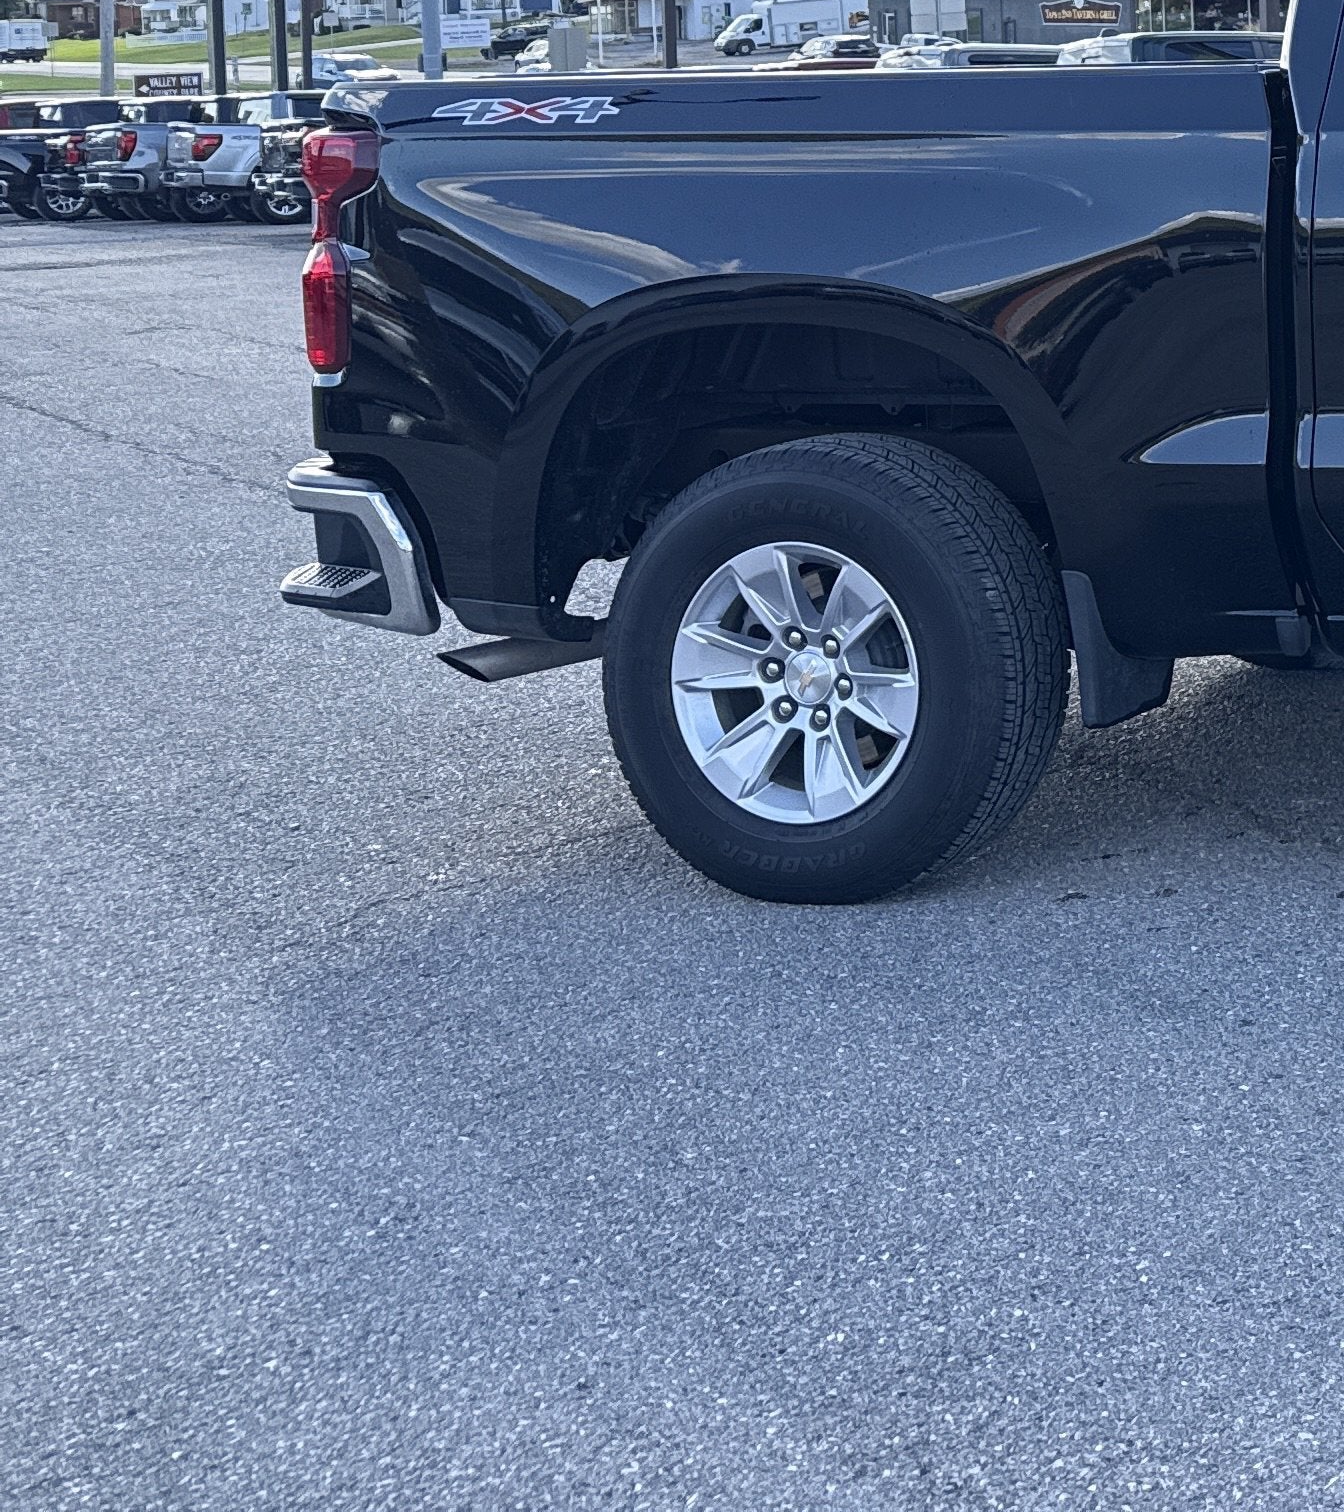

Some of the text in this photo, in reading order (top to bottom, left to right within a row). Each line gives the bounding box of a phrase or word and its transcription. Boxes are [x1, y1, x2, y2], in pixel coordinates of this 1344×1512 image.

[148, 75, 199, 88] VALLEY VIEW
[431, 96, 620, 125] 4X4
